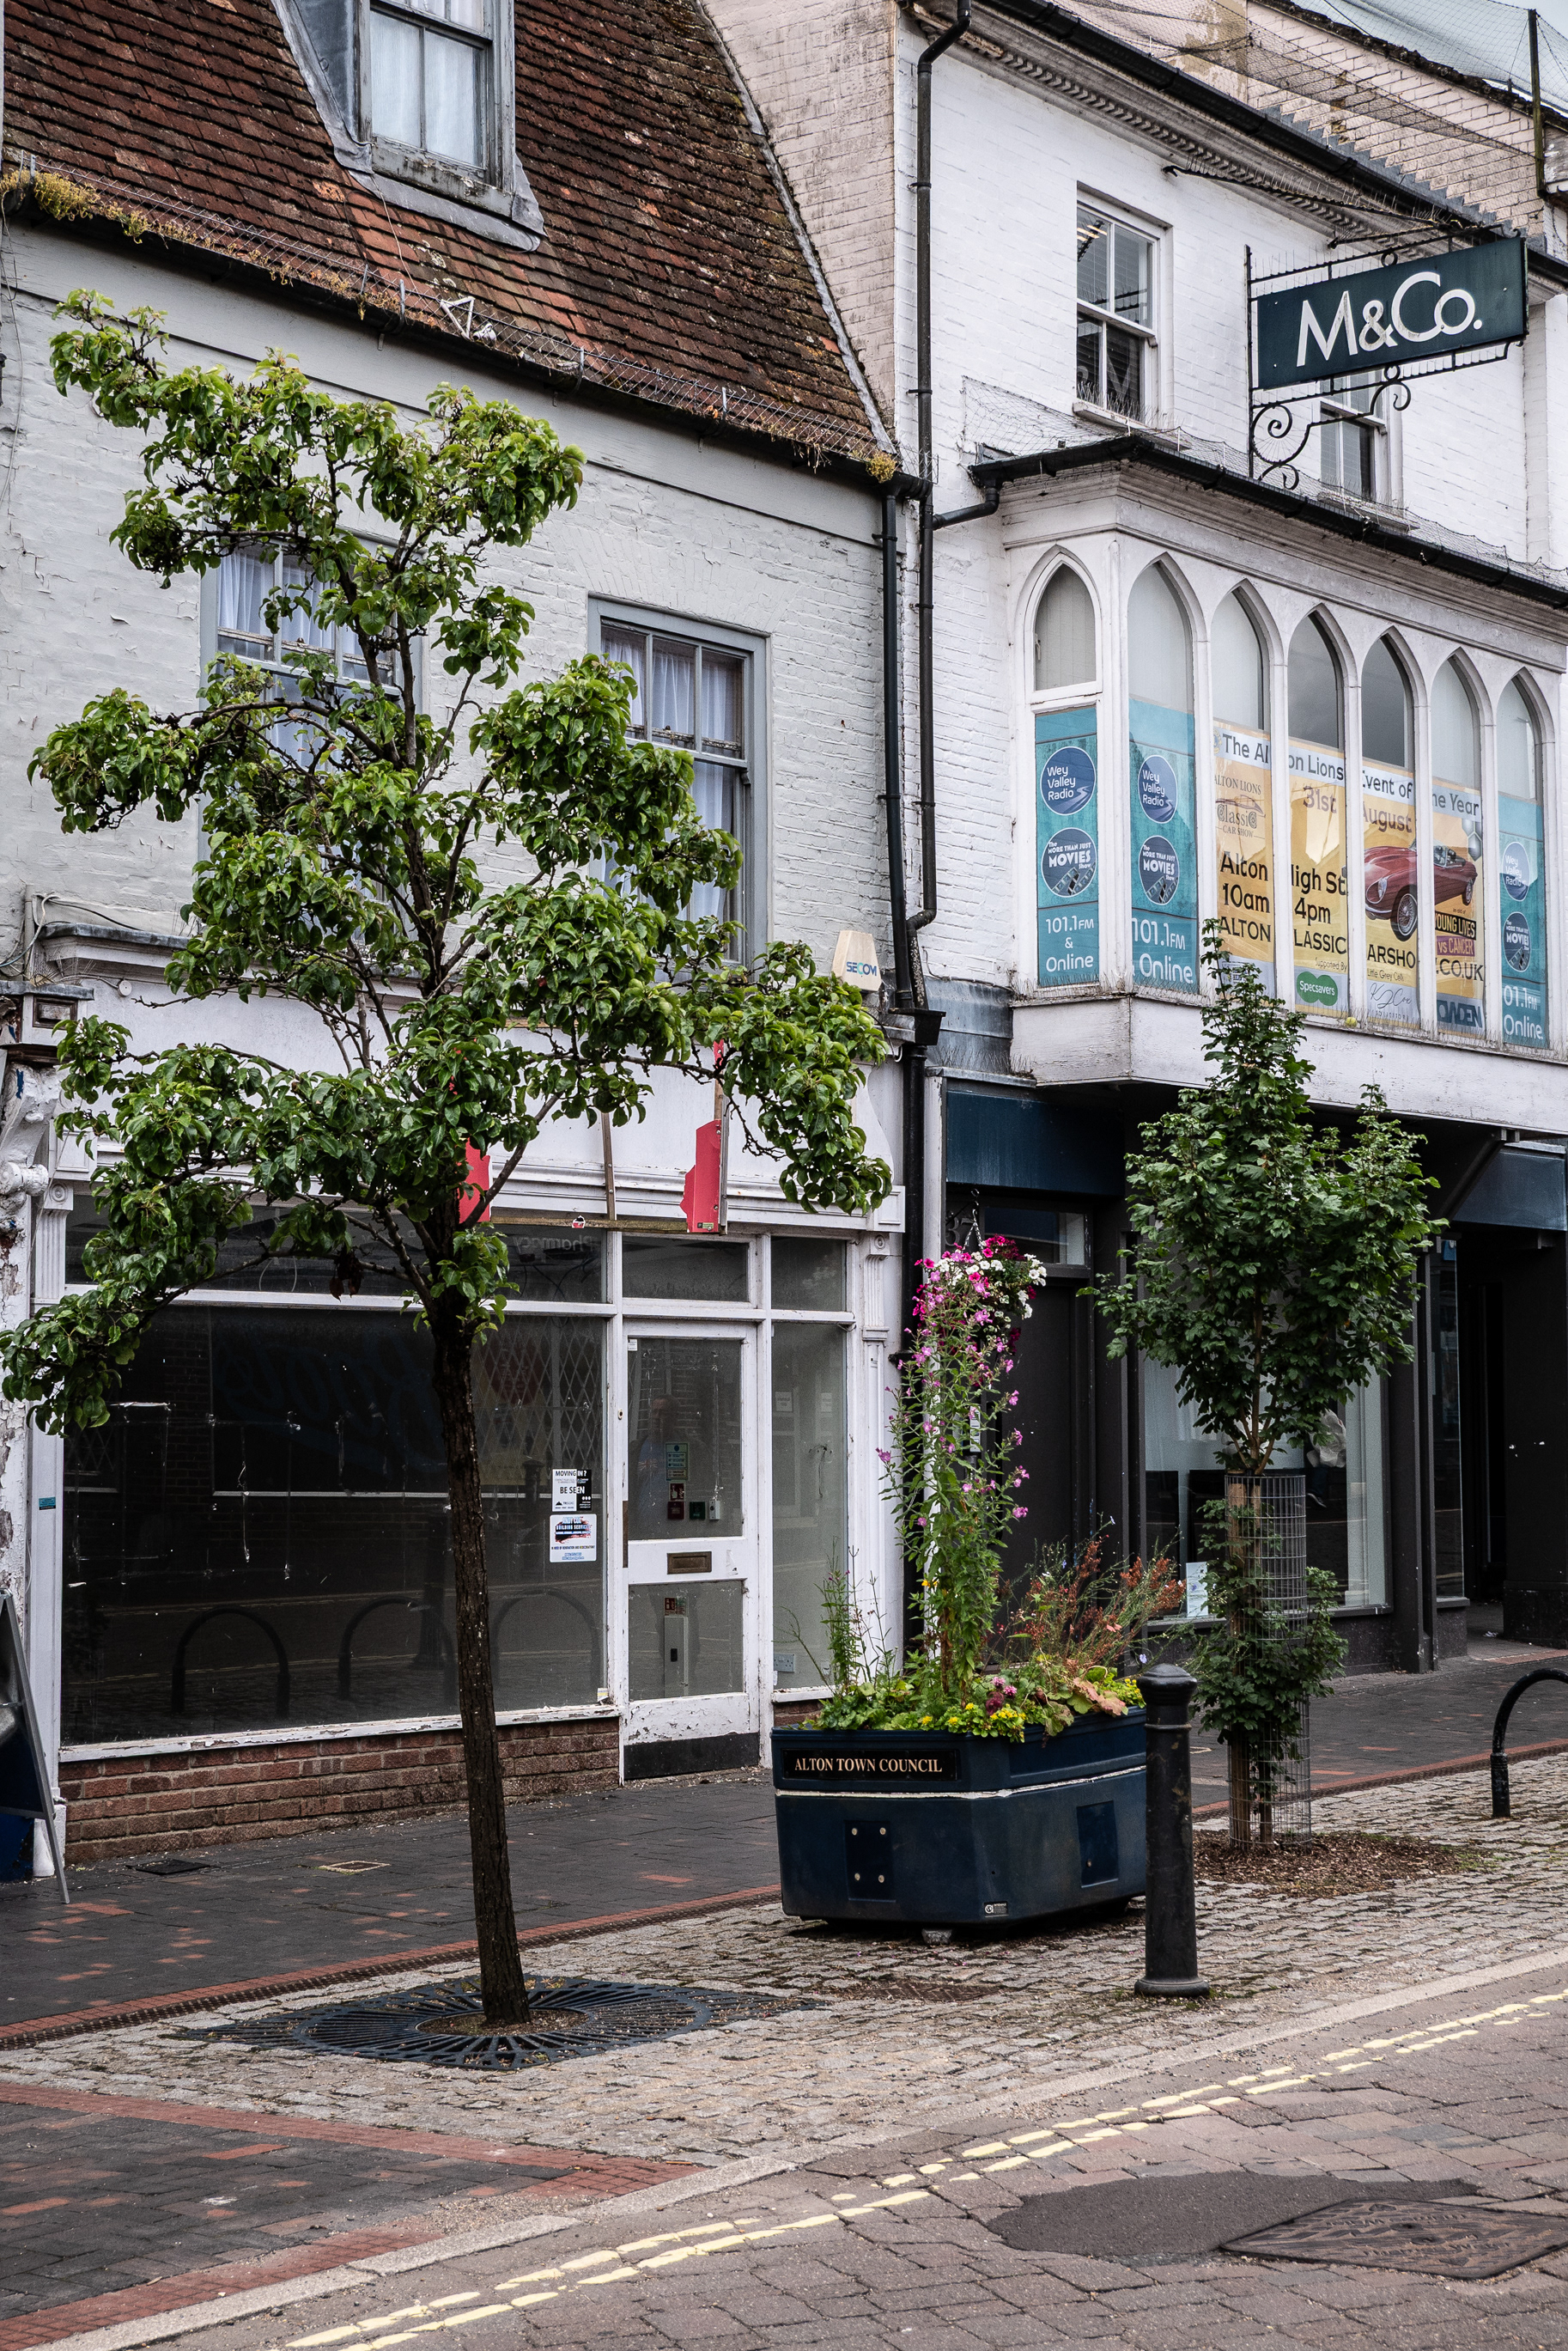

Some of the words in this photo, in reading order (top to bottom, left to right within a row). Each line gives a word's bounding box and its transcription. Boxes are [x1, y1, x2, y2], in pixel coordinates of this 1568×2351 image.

[1296, 271, 1483, 368] M&Co.
[1047, 766, 1068, 777] Wey
[1142, 770, 1160, 784] Wey
[1223, 734, 1249, 758] The
[1254, 743, 1269, 764] Al
[1308, 755, 1344, 781] Lions
[1399, 782, 1413, 799] of
[1449, 793, 1479, 816] Year
[1047, 777, 1076, 789] Valley
[1142, 782, 1165, 798] Valley
[1214, 775, 1238, 789] ALTON
[1240, 780, 1261, 795] LIONS
[1048, 788, 1074, 801] Radio
[1142, 794, 1164, 807] Radio
[1304, 786, 1337, 813] 31st
[1223, 825, 1237, 835] CAR
[1237, 826, 1254, 838] SHOW
[1048, 850, 1091, 868] MOVIES
[1143, 858, 1176, 875] MOVIES
[1220, 851, 1268, 881] Alton
[1504, 855, 1519, 868] Wey
[1505, 866, 1522, 879] Valley
[1505, 875, 1522, 886] Radio
[1223, 883, 1270, 914] 10am
[1294, 898, 1331, 926] 4pm
[1458, 918, 1475, 938] LIVES
[1065, 937, 1073, 948] &
[1219, 916, 1271, 942] ALTON
[1294, 929, 1347, 954] LASSIC
[1367, 943, 1416, 969] ARSHO
[1436, 958, 1484, 982] .CO.UK
[1437, 941, 1448, 953] vs
[1448, 937, 1474, 955] CANCER
[846, 961, 878, 976] SECOM
[1046, 953, 1093, 972] Online
[1139, 953, 1194, 984] Online
[1340, 961, 1347, 972] By
[1379, 969, 1392, 981] Grey
[1299, 980, 1335, 996] Specsavers
[1504, 1014, 1544, 1040] Online
[568, 1486, 586, 1495] SEEN
[794, 1757, 834, 1771] ALTON
[836, 1758, 876, 1772] TOWN
[878, 1758, 943, 1773] COUNCIL
